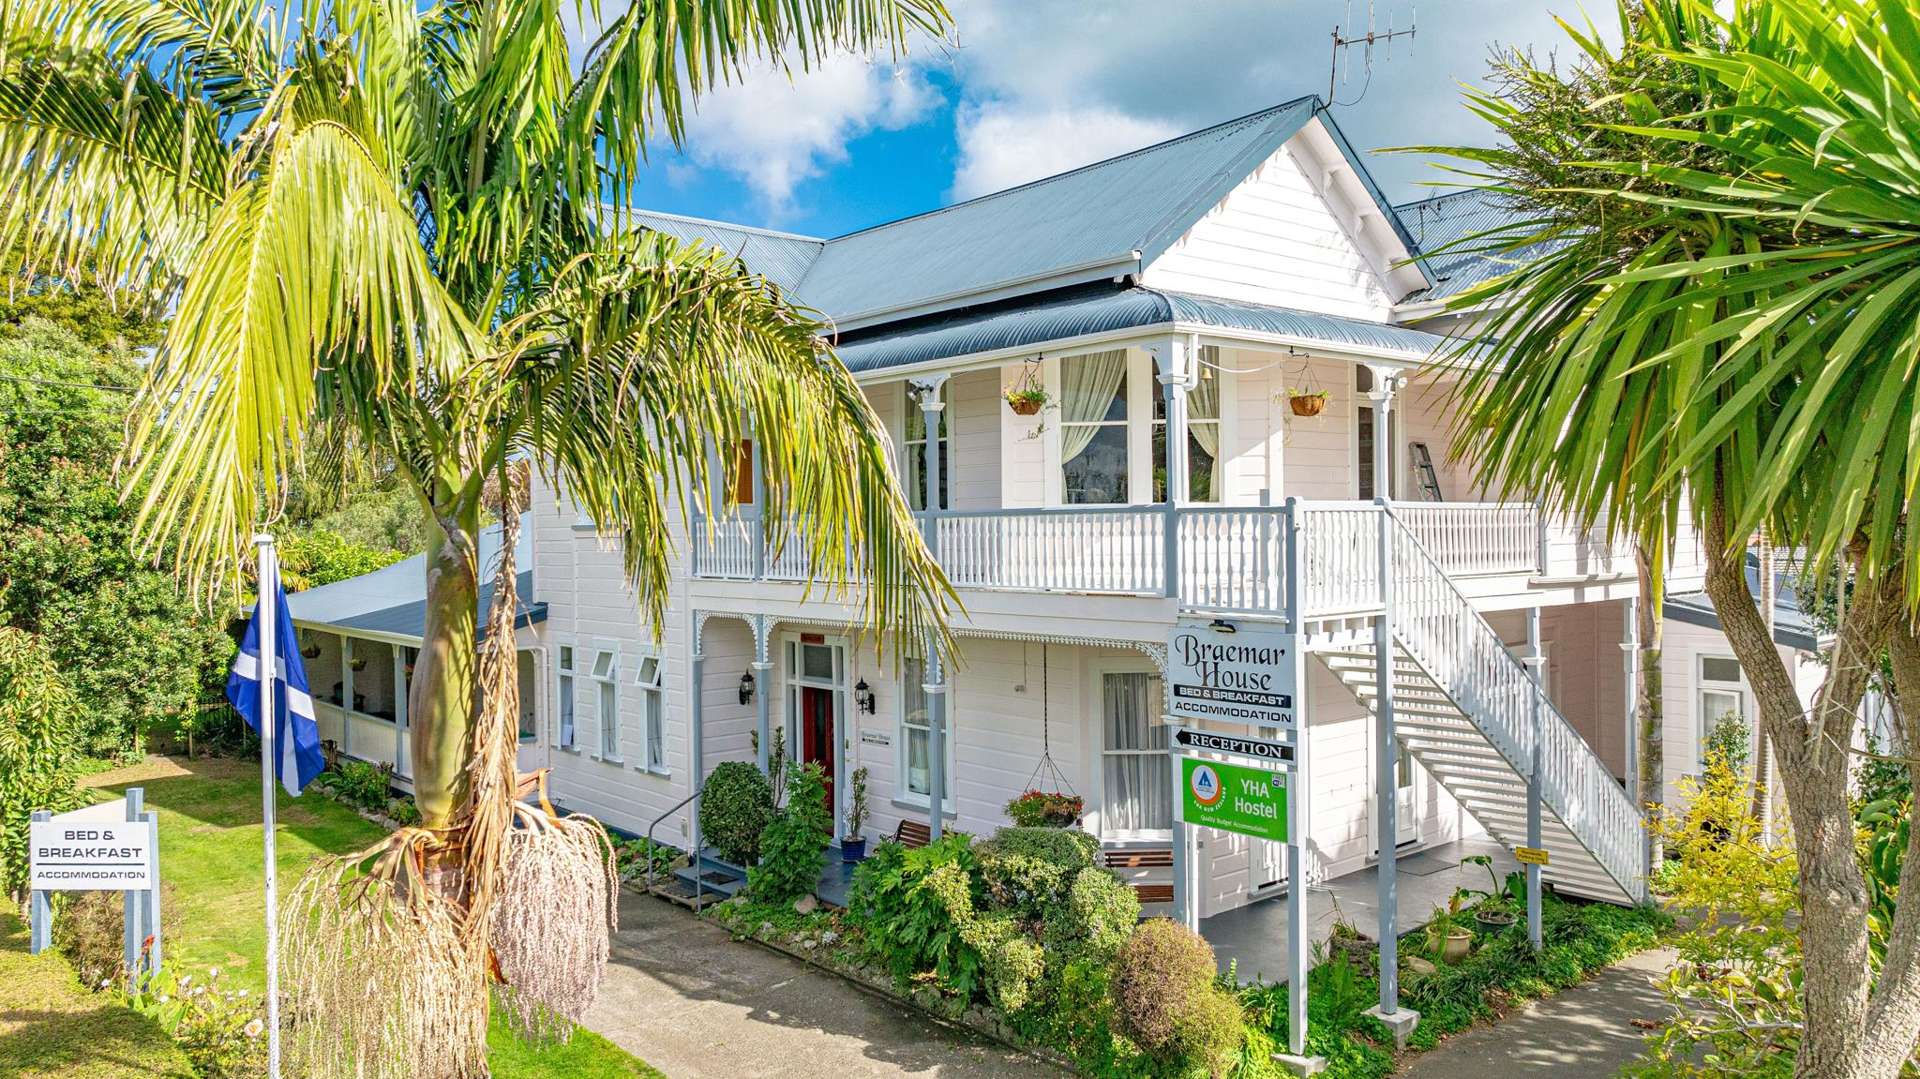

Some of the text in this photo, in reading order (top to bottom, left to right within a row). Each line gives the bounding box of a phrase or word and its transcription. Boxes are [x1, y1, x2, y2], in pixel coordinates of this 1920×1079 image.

[1175, 634, 1285, 667] Braemar
[1195, 660, 1271, 690] House
[1179, 686, 1284, 706] BED & BREAKFAST
[1175, 701, 1291, 723] ACCOMMODATION
[1190, 733, 1282, 758] RECEPTION
[1240, 778, 1270, 799] YHA
[1235, 797, 1277, 820] Hostel
[65, 830, 114, 841] BED &
[39, 848, 142, 858] BREAKFAST
[37, 871, 145, 879] ACCOMMODATION
